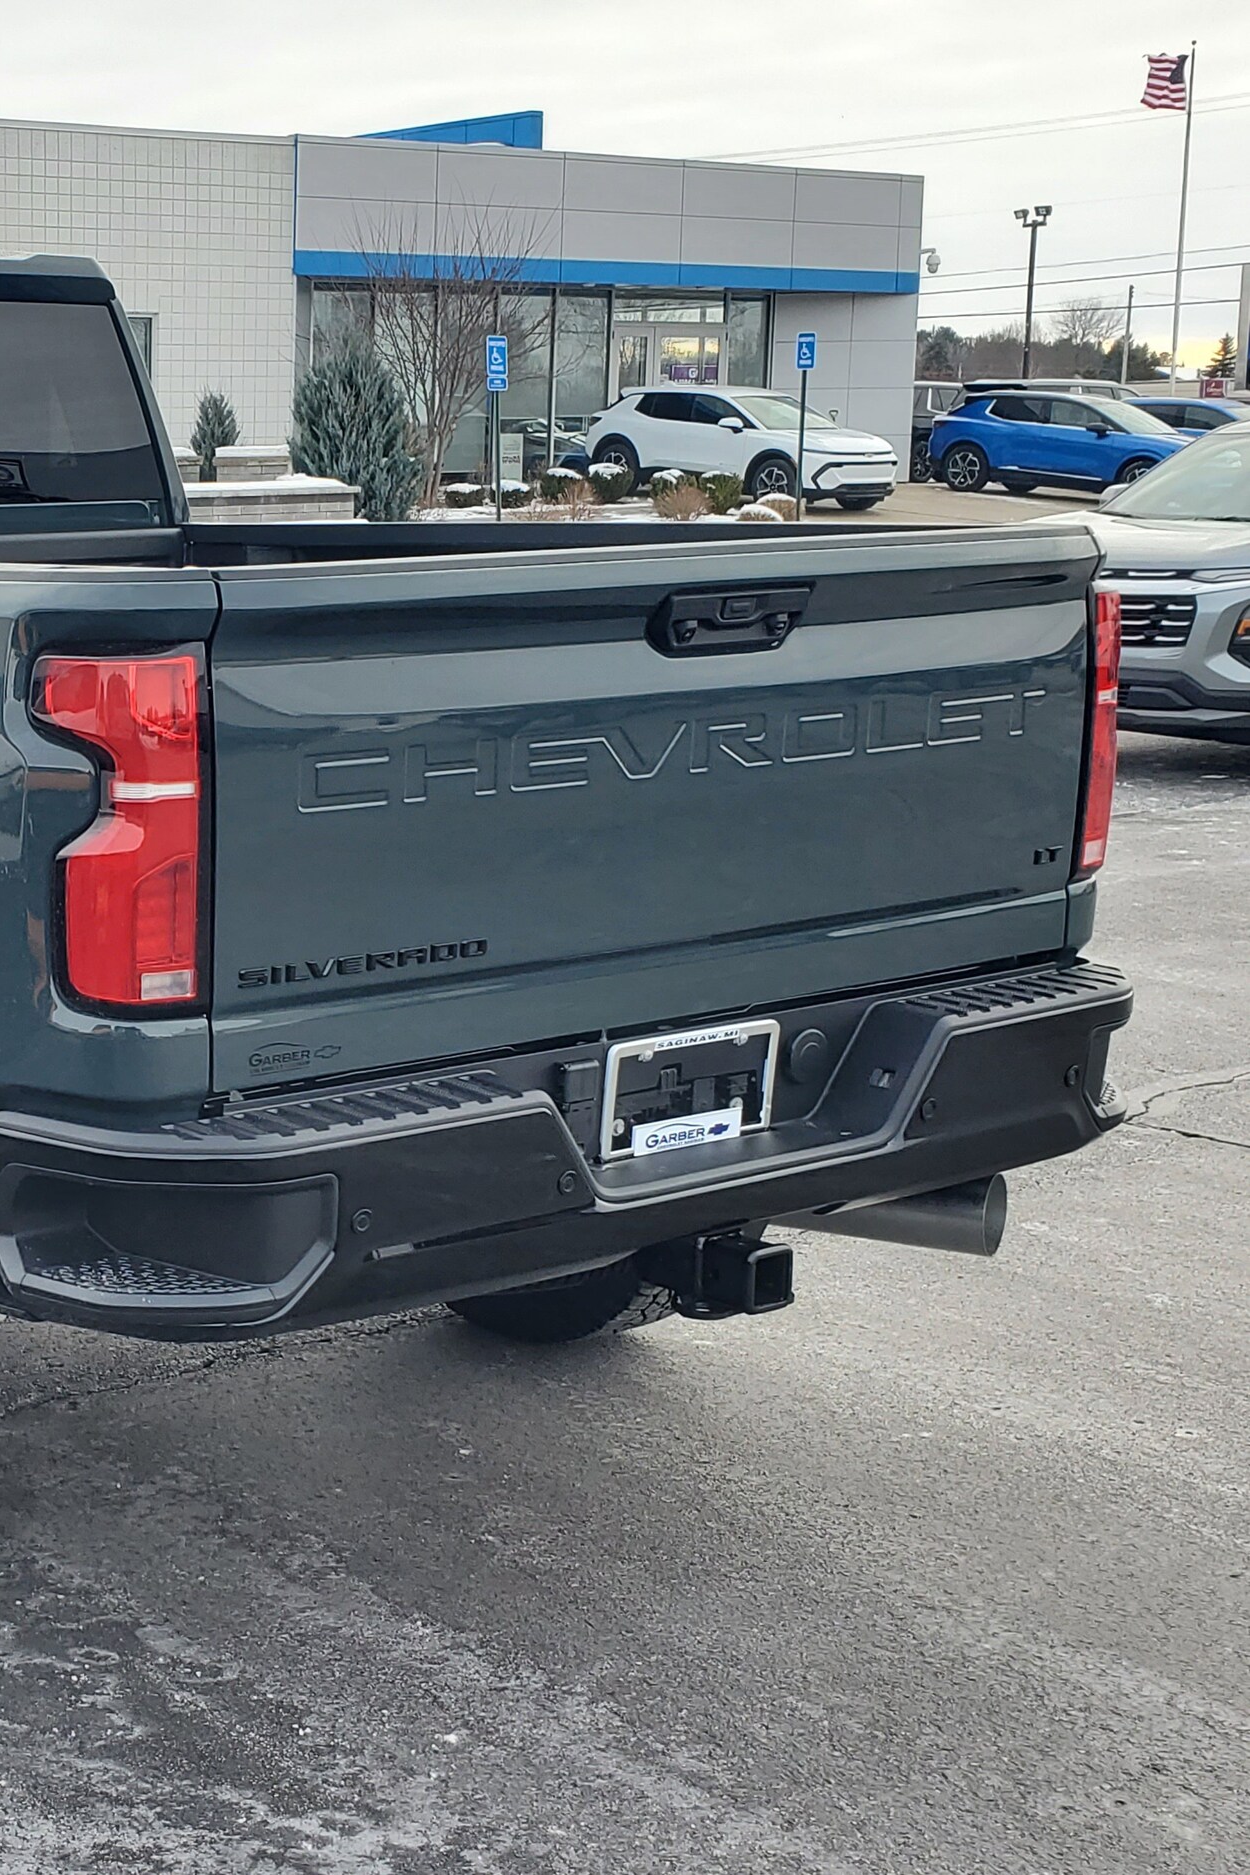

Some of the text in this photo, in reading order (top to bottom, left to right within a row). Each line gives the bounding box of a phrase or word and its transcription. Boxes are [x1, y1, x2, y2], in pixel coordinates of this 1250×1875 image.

[299, 690, 1046, 814] CHEVROLET
[1033, 845, 1063, 865] LT
[238, 937, 488, 989] SILVERADO
